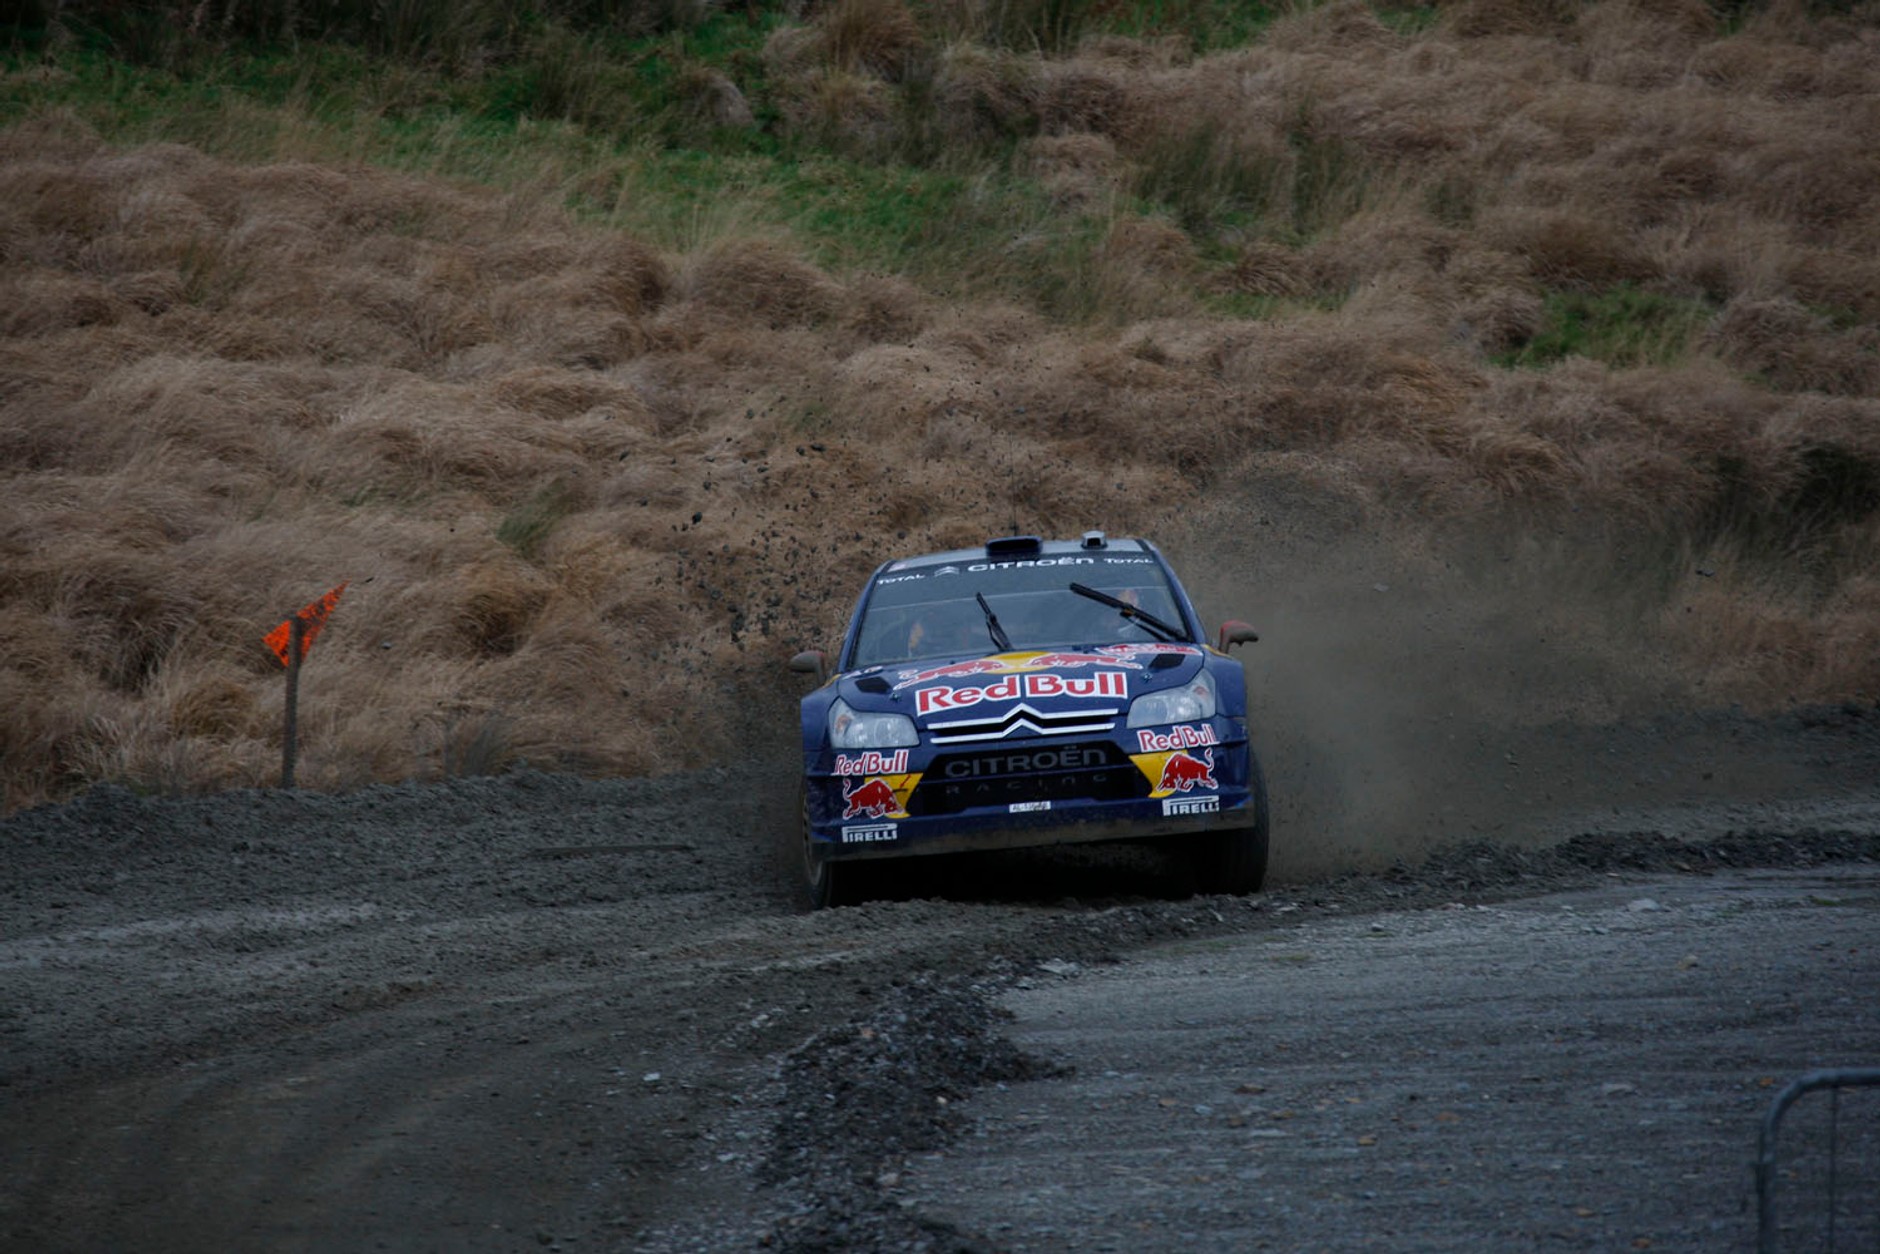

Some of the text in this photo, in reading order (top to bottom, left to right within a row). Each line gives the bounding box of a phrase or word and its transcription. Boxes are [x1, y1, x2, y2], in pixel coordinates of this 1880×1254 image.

[1102, 557, 1154, 565] TOTAL
[876, 573, 925, 585] TOTAL
[917, 673, 1127, 714] Red Bull
[1137, 723, 1219, 752] Red Bull
[833, 750, 909, 775] Red Bull
[1162, 795, 1220, 816] PIRELLI
[842, 822, 898, 843] PIRELLI
